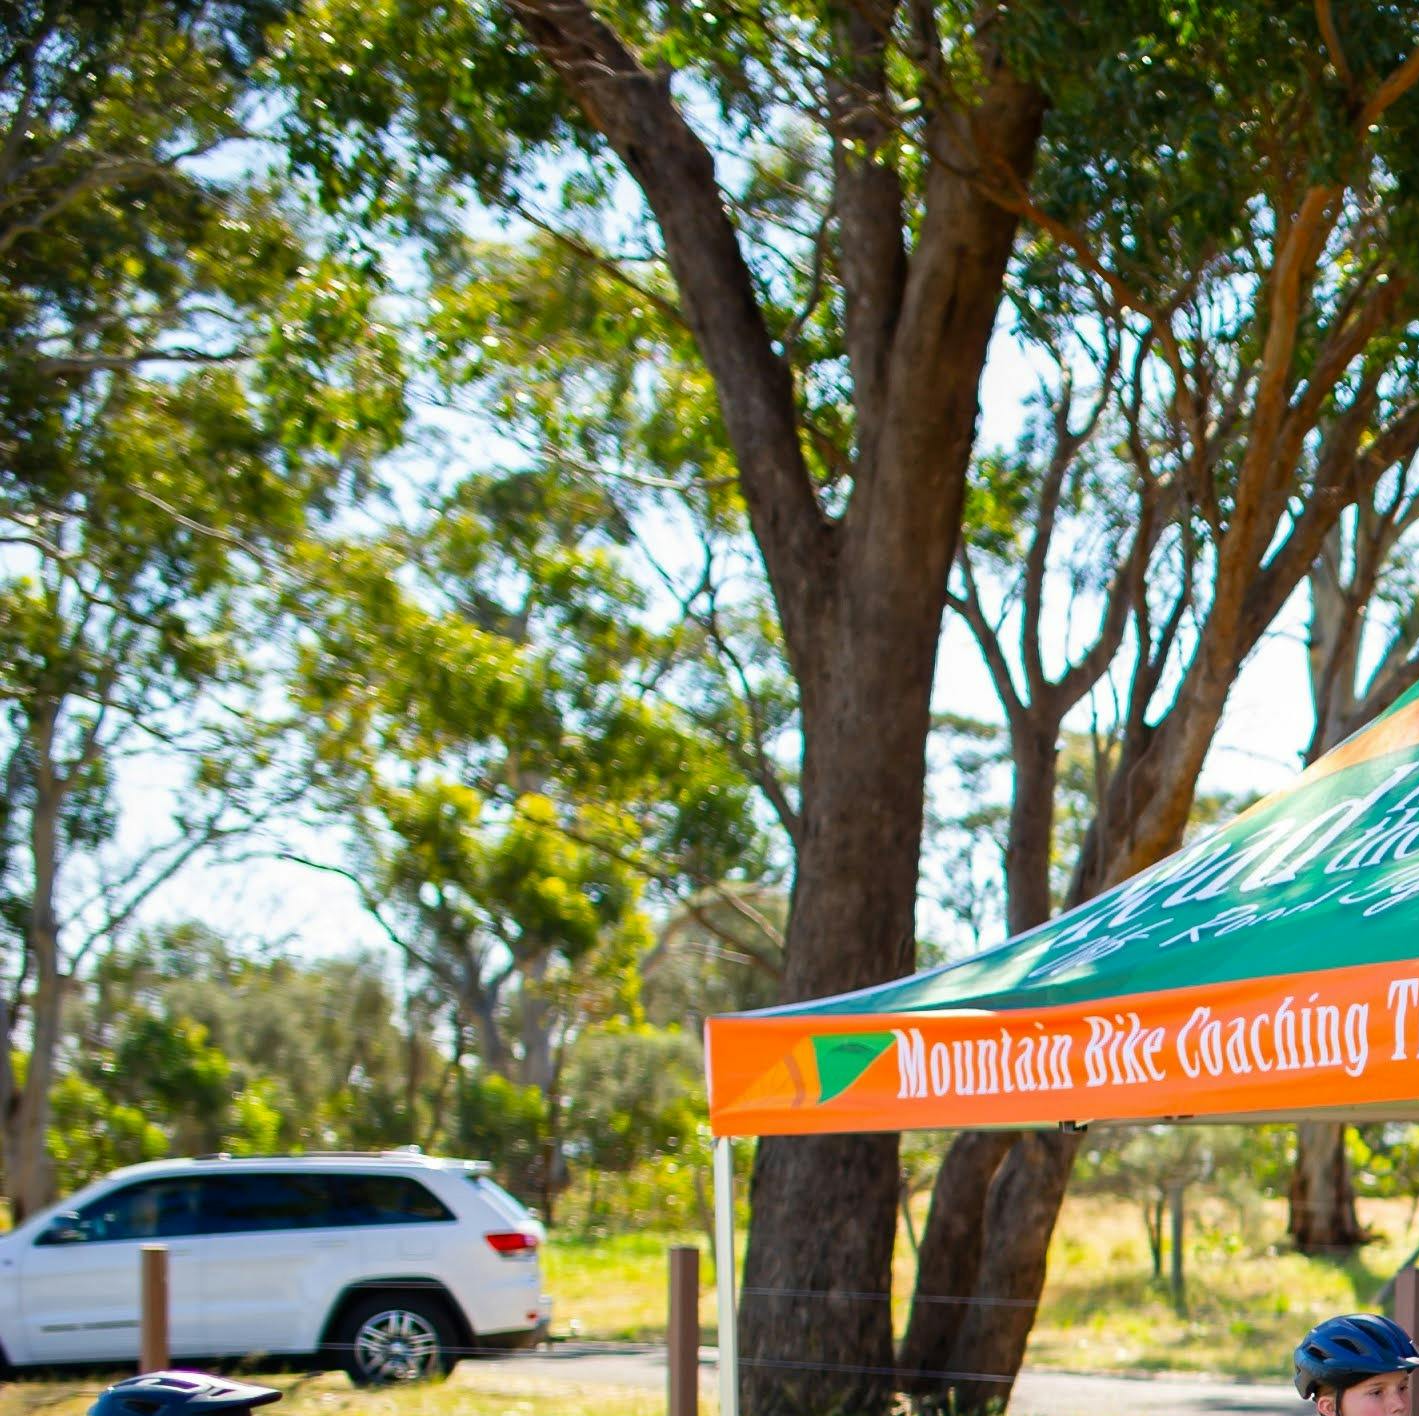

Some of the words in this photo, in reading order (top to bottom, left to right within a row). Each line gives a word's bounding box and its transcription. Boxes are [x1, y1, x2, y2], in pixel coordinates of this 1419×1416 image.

[890, 1022, 1074, 1100] Mountain
[1083, 1011, 1167, 1089] Bike
[1175, 992, 1370, 1078] Coaching
